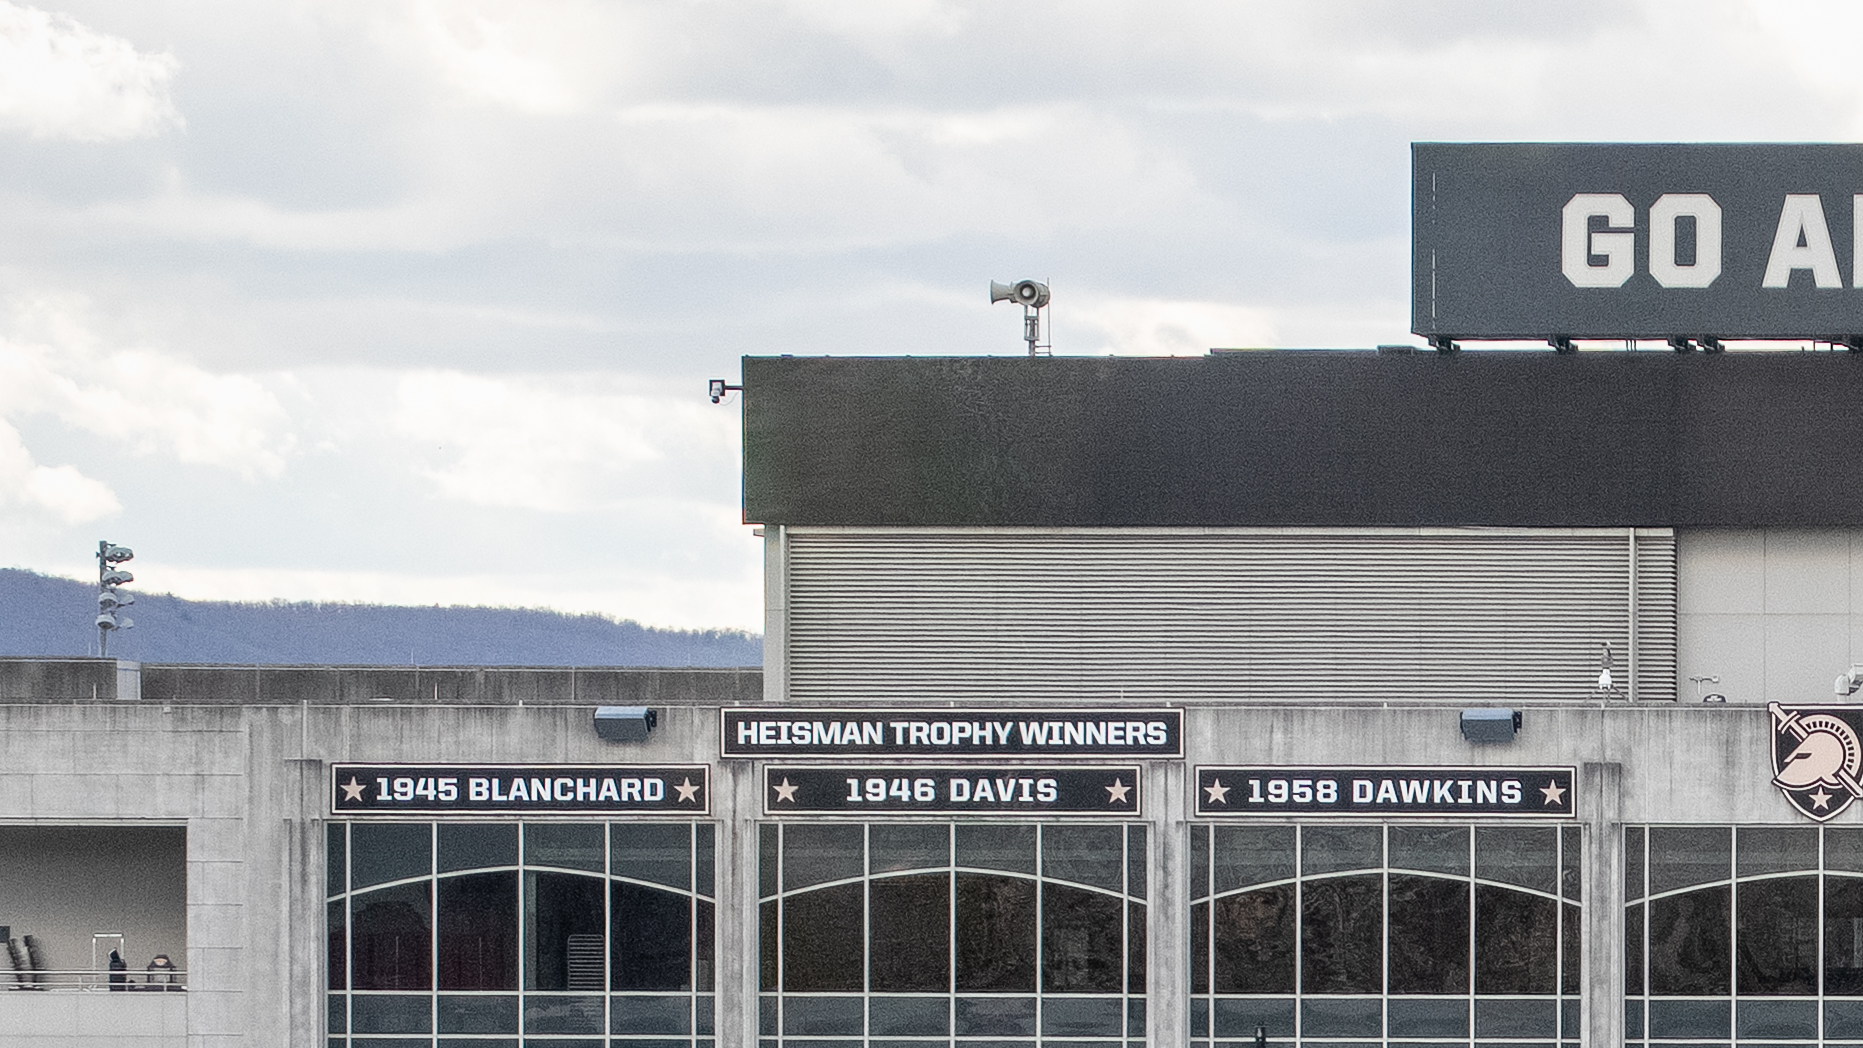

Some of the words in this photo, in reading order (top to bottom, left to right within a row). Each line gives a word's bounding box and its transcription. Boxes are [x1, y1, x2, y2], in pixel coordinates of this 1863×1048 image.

[1562, 194, 1722, 289] GO
[738, 722, 884, 746] HEISMAN
[890, 722, 1015, 746] TROPHY
[1019, 722, 1168, 747] WINNERS
[376, 778, 459, 802] 1945
[469, 778, 665, 803] BLANCHARD
[846, 779, 936, 803] 1946
[950, 779, 1058, 803] DAVIS
[1248, 779, 1339, 804] 1958
[1353, 780, 1522, 805] DAWKINS
